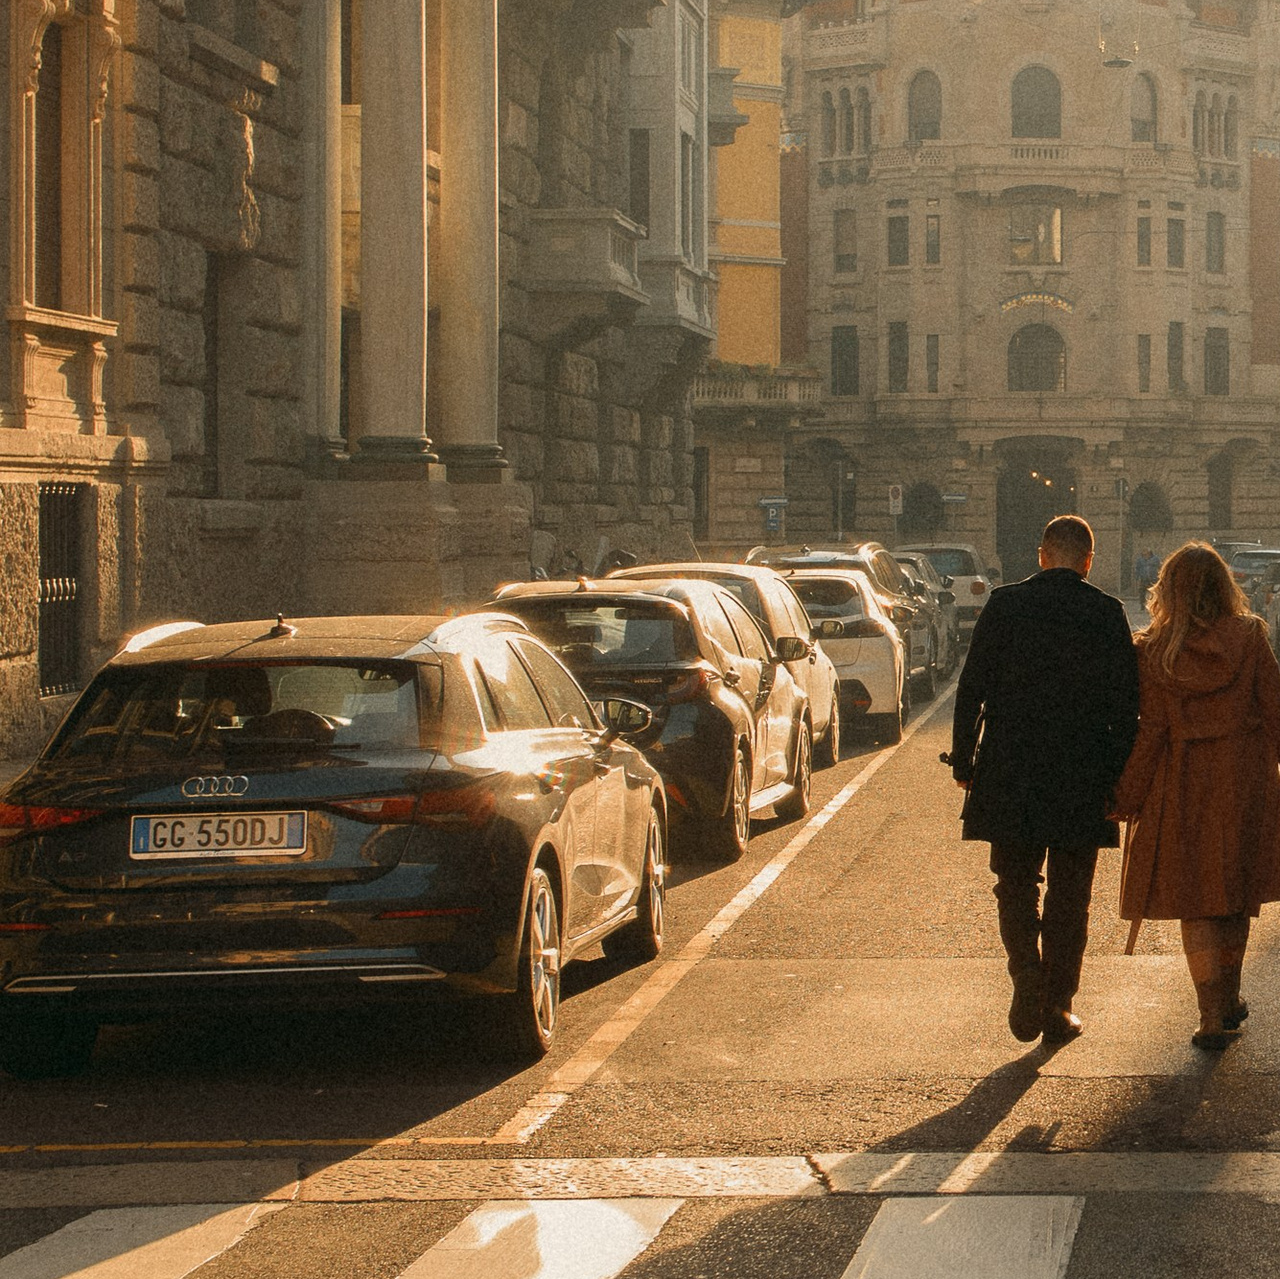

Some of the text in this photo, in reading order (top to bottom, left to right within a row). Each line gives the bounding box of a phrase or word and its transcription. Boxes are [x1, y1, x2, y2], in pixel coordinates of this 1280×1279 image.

[769, 508, 777, 520] P
[152, 816, 285, 849] GG 550DJ
